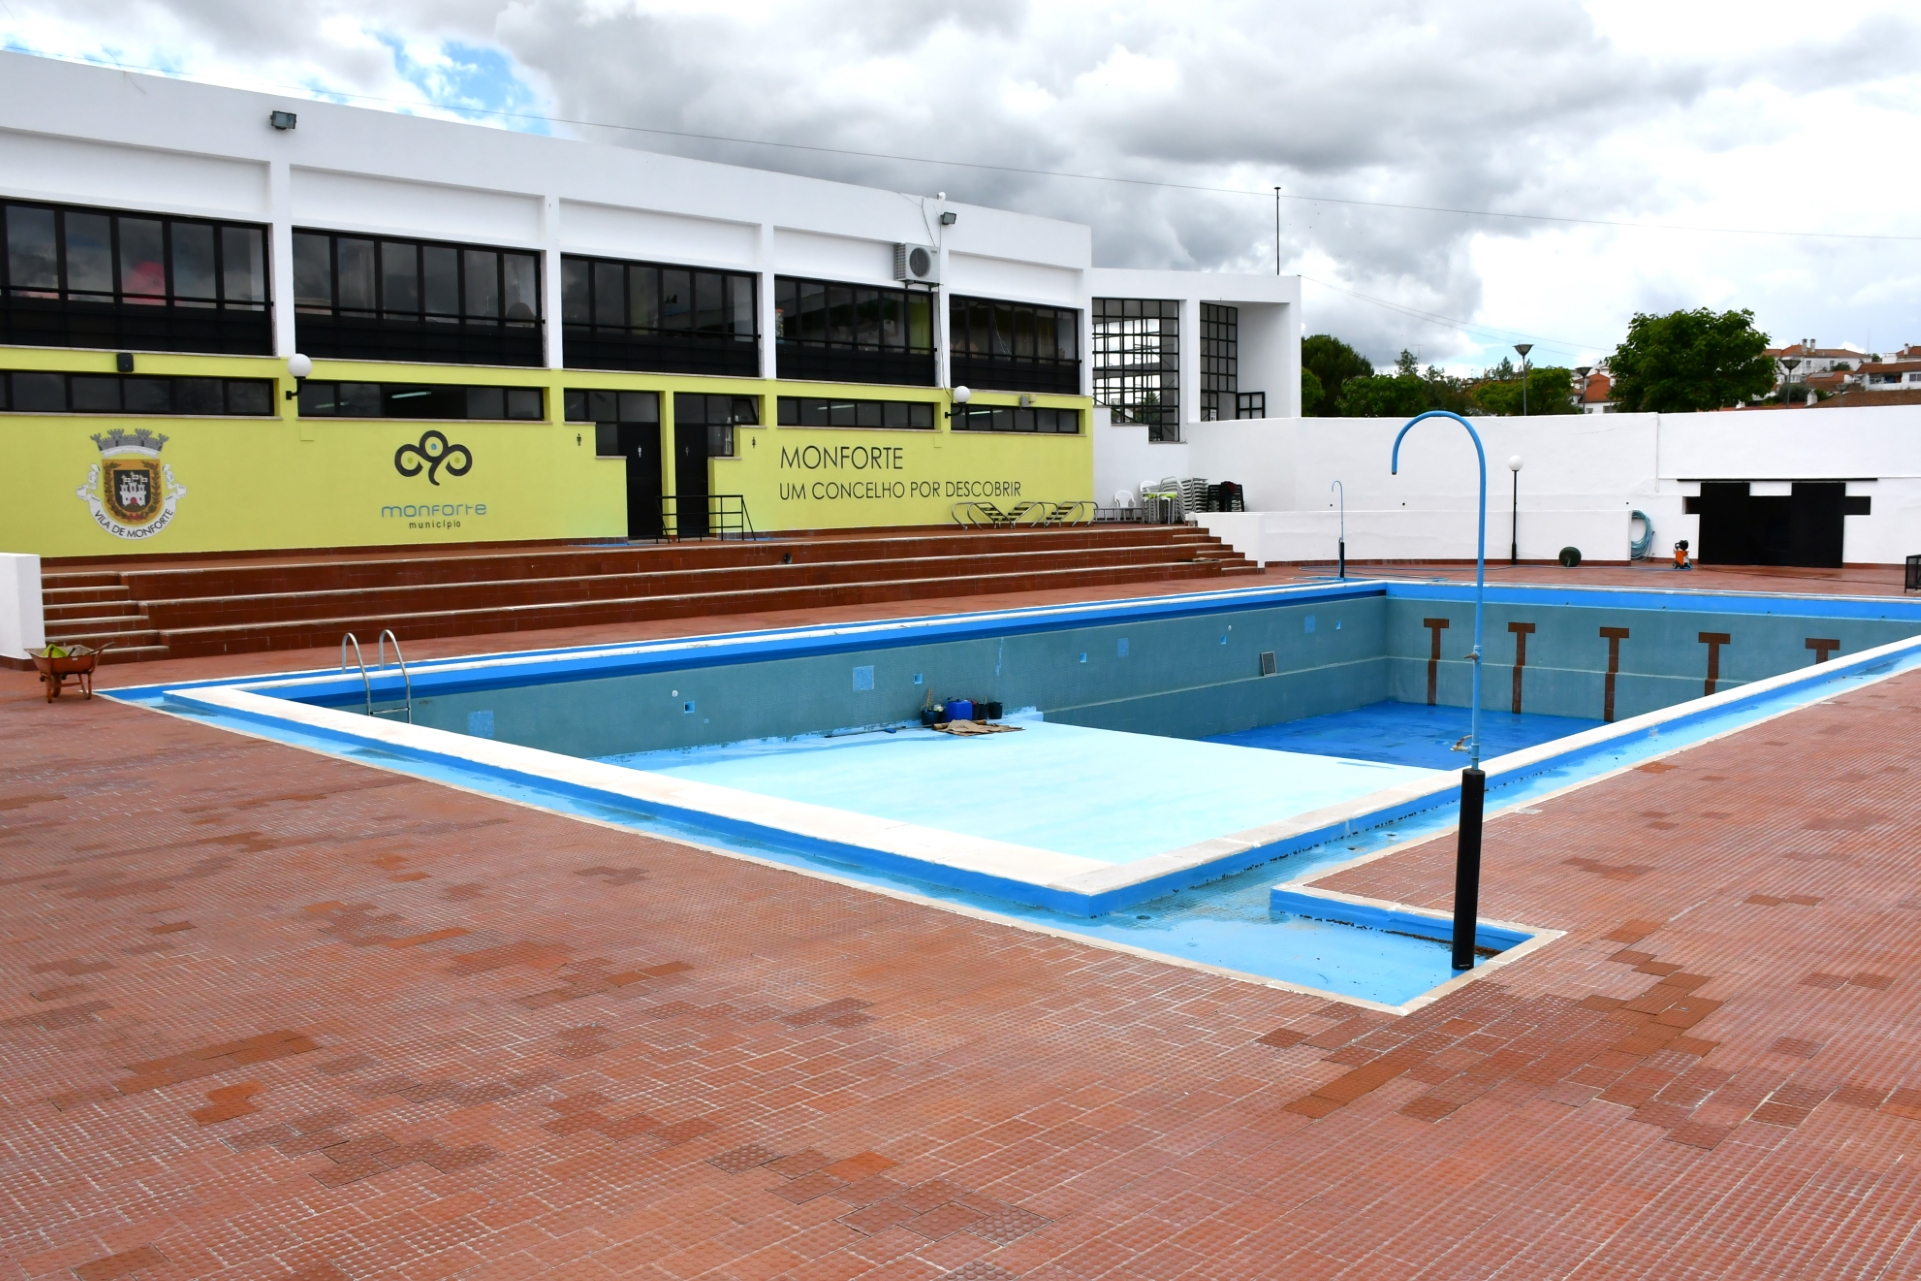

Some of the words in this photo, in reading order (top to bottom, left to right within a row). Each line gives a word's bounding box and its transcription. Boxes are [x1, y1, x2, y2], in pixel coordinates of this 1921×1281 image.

[780, 445, 903, 470] MONFORTE
[779, 482, 806, 500] UM
[811, 481, 905, 500] CONCELHO
[910, 481, 941, 498] POR
[945, 481, 1021, 498] DESCOBRIR
[94, 509, 110, 530] VILA
[111, 524, 125, 537] DE
[126, 508, 174, 538] MONFORTE
[408, 519, 461, 530] município
